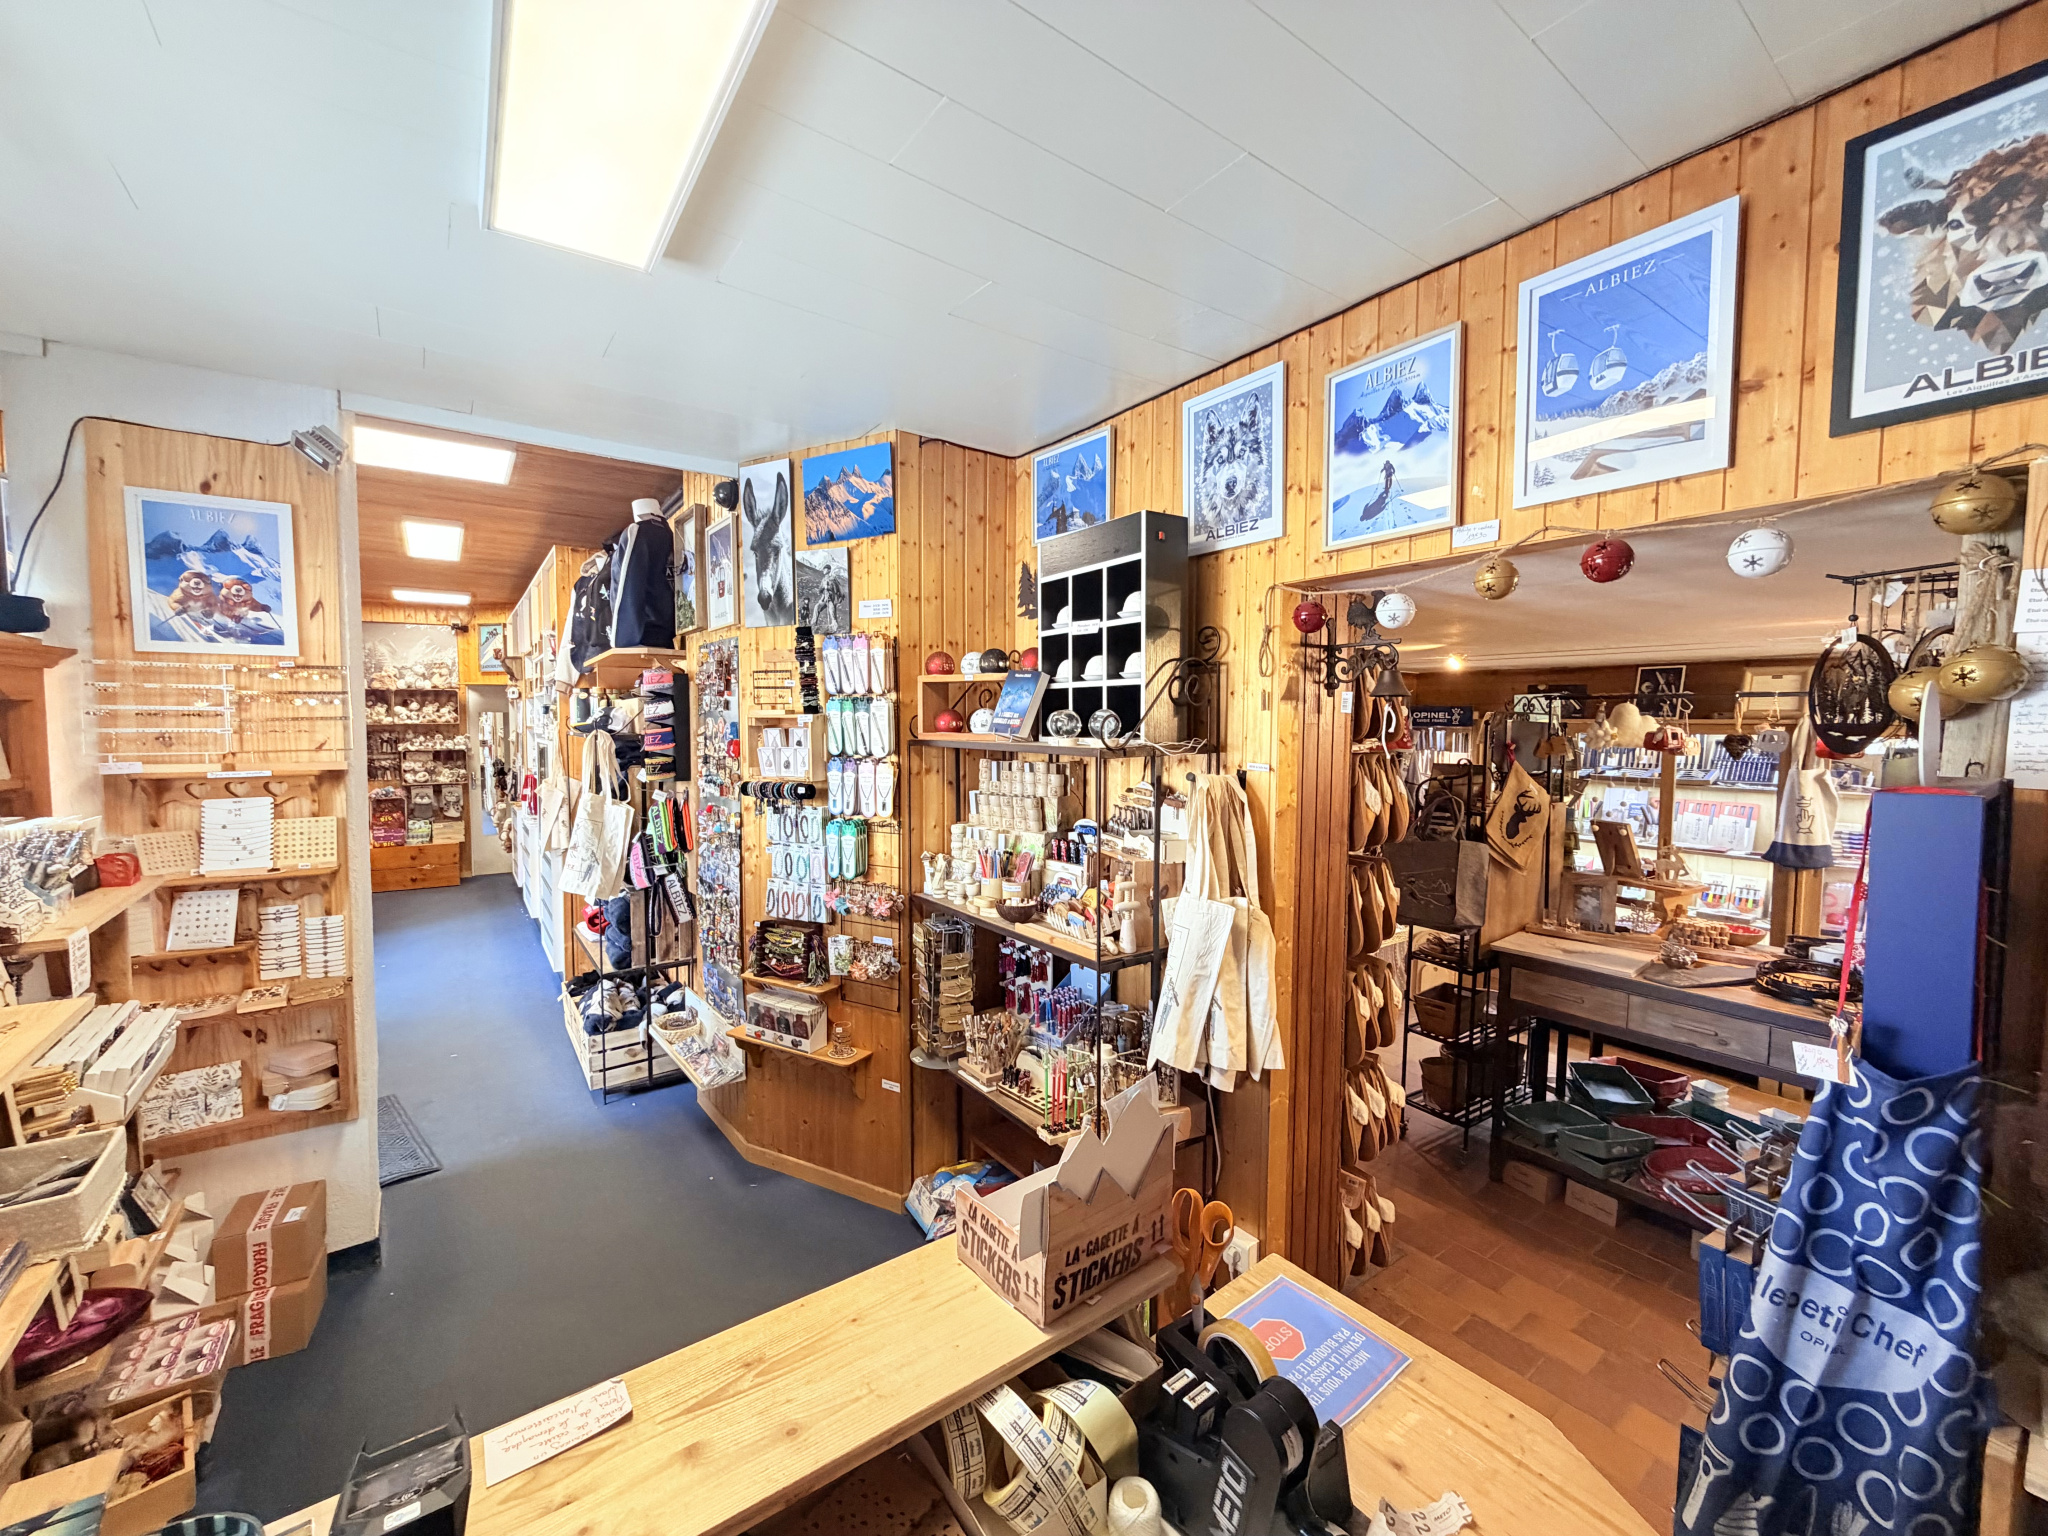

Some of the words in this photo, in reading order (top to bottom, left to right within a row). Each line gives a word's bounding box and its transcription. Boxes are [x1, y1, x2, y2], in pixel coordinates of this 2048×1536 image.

[1585, 259, 1657, 297] ALBIEZ
[1366, 356, 1417, 391] ALBIEZ
[1946, 388, 1963, 396] Les
[1966, 379, 2010, 392] Aiguilles
[1043, 454, 1060, 467] ALBIEZ
[189, 508, 236, 524] ALBIEZ
[1206, 519, 1259, 542] ALBIEZ
[1413, 711, 1452, 719] OPINEL
[667, 879, 687, 914] ALBIEZ
[252, 1200, 280, 1232] FRAGILE
[968, 1201, 978, 1224] LA
[980, 1213, 1010, 1254] CAGETTE
[960, 1218, 1021, 1302] STICKERS
[1052, 1236, 1145, 1310] STICKERS
[1265, 1326, 1293, 1352] STOP
[1332, 1327, 1351, 1342] PAS
[1340, 1331, 1367, 1360] DEVANT
[1852, 1311, 1927, 1367] Chef
[1304, 1338, 1339, 1367] BLOQUER
[1333, 1353, 1345, 1366] LA
[1345, 1350, 1371, 1373] MERCI
[1296, 1362, 1311, 1376] LE
[1335, 1366, 1352, 1381] DE
[1318, 1375, 1343, 1396] VOUS
[598, 1390, 625, 1408] Merci
[1205, 1455, 1248, 1536] METO
[1433, 1506, 1451, 1522] METO
